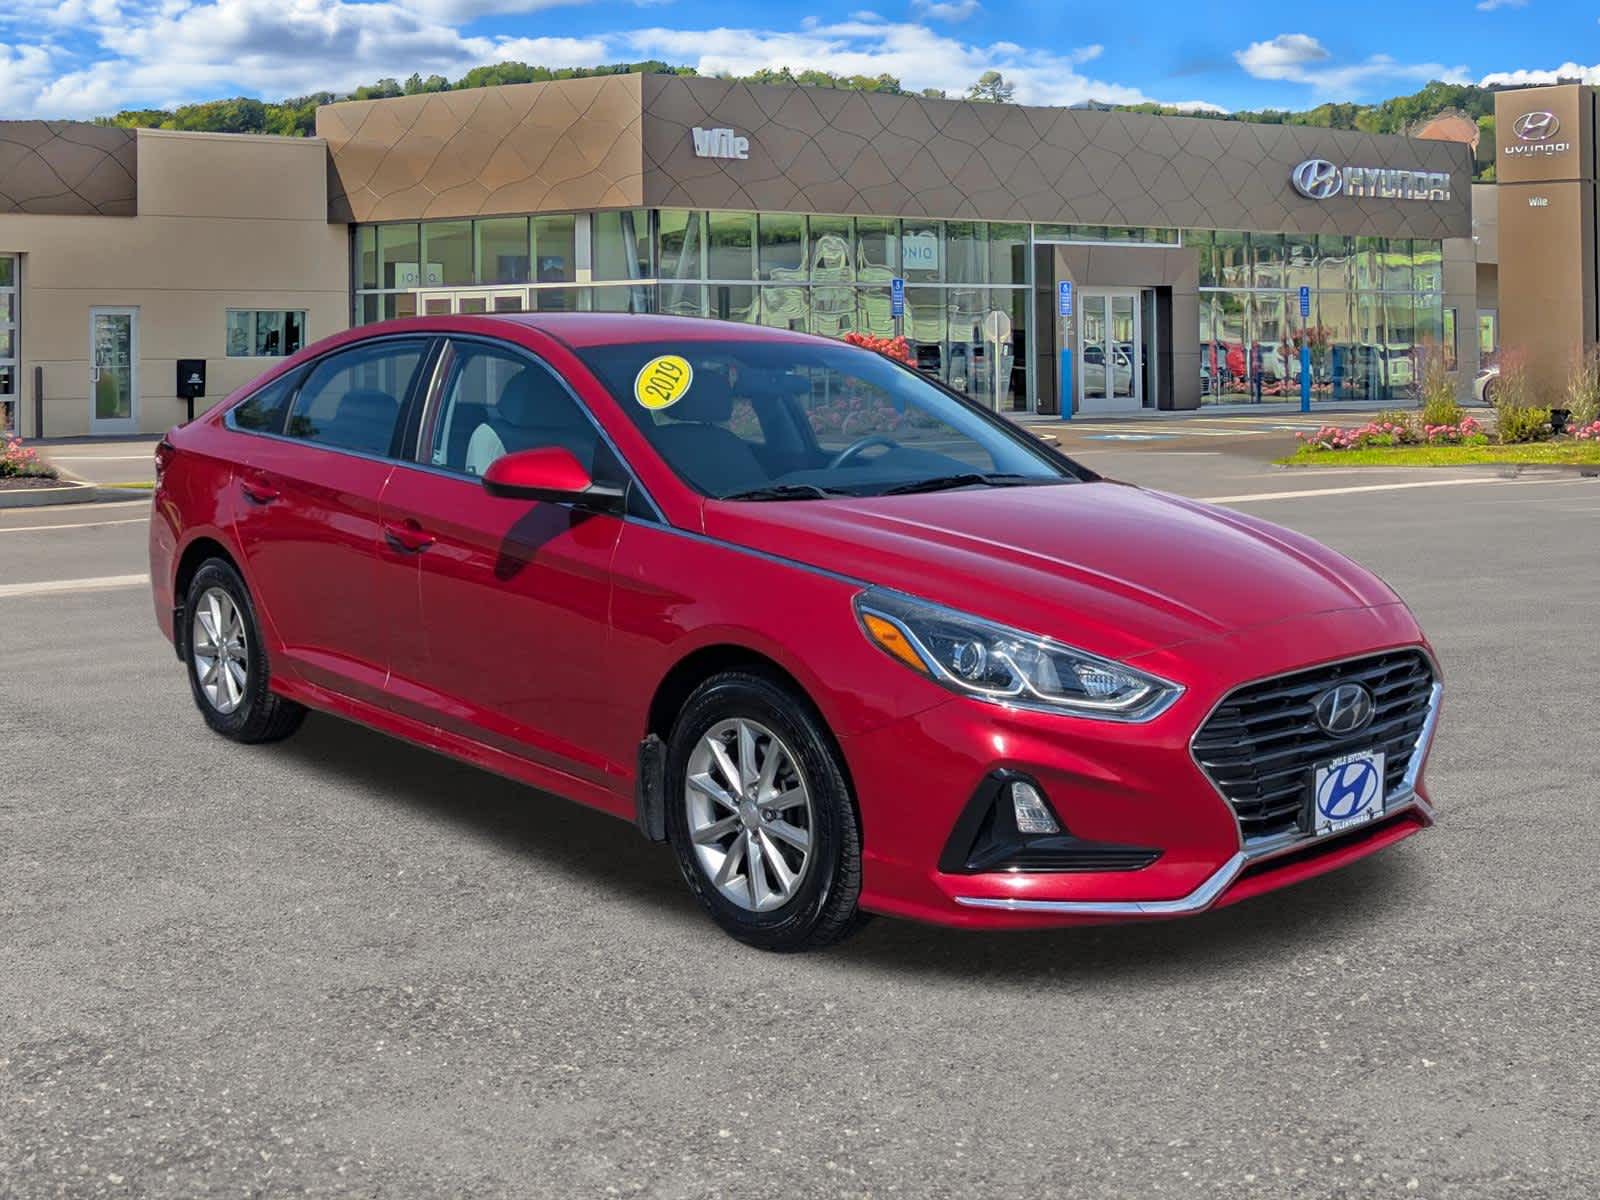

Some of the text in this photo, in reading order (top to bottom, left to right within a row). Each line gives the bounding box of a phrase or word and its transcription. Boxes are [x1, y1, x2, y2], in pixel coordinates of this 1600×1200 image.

[692, 127, 749, 159] Wile
[1344, 167, 1450, 200] HYUNDAI
[645, 361, 682, 401] 2019
